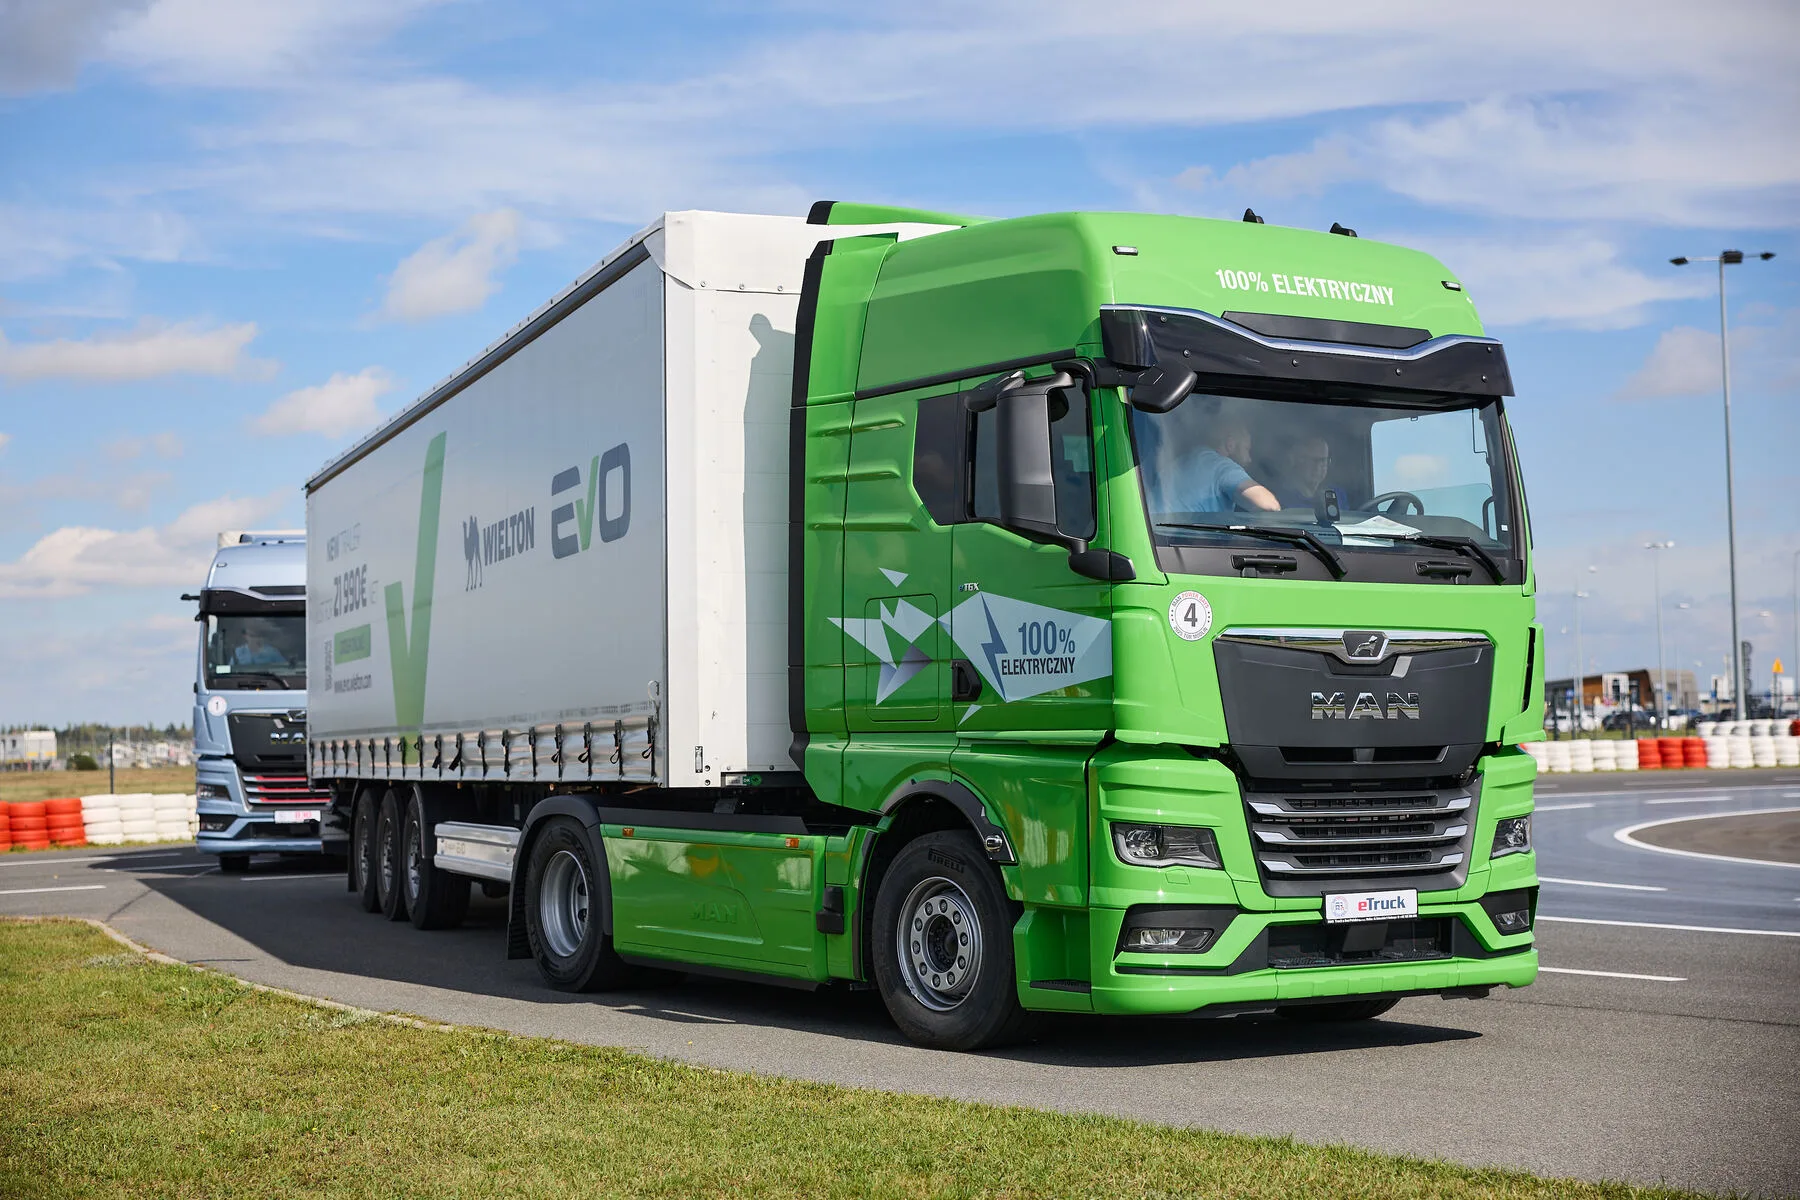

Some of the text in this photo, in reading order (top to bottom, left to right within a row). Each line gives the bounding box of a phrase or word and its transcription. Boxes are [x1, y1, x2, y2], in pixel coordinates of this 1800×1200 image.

[1216, 269, 1394, 306] 100% ELEKTRYCZNY
[551, 442, 631, 560] EVO
[483, 506, 535, 566] WIELTON
[343, 563, 367, 615] 990€
[1184, 603, 1197, 627] 4
[1018, 620, 1076, 655] 100%
[1001, 656, 1076, 676] ELEKTRYCZNY
[1311, 691, 1420, 720] MAN
[928, 848, 967, 874] PIRELLI
[1358, 895, 1406, 912] eTruck
